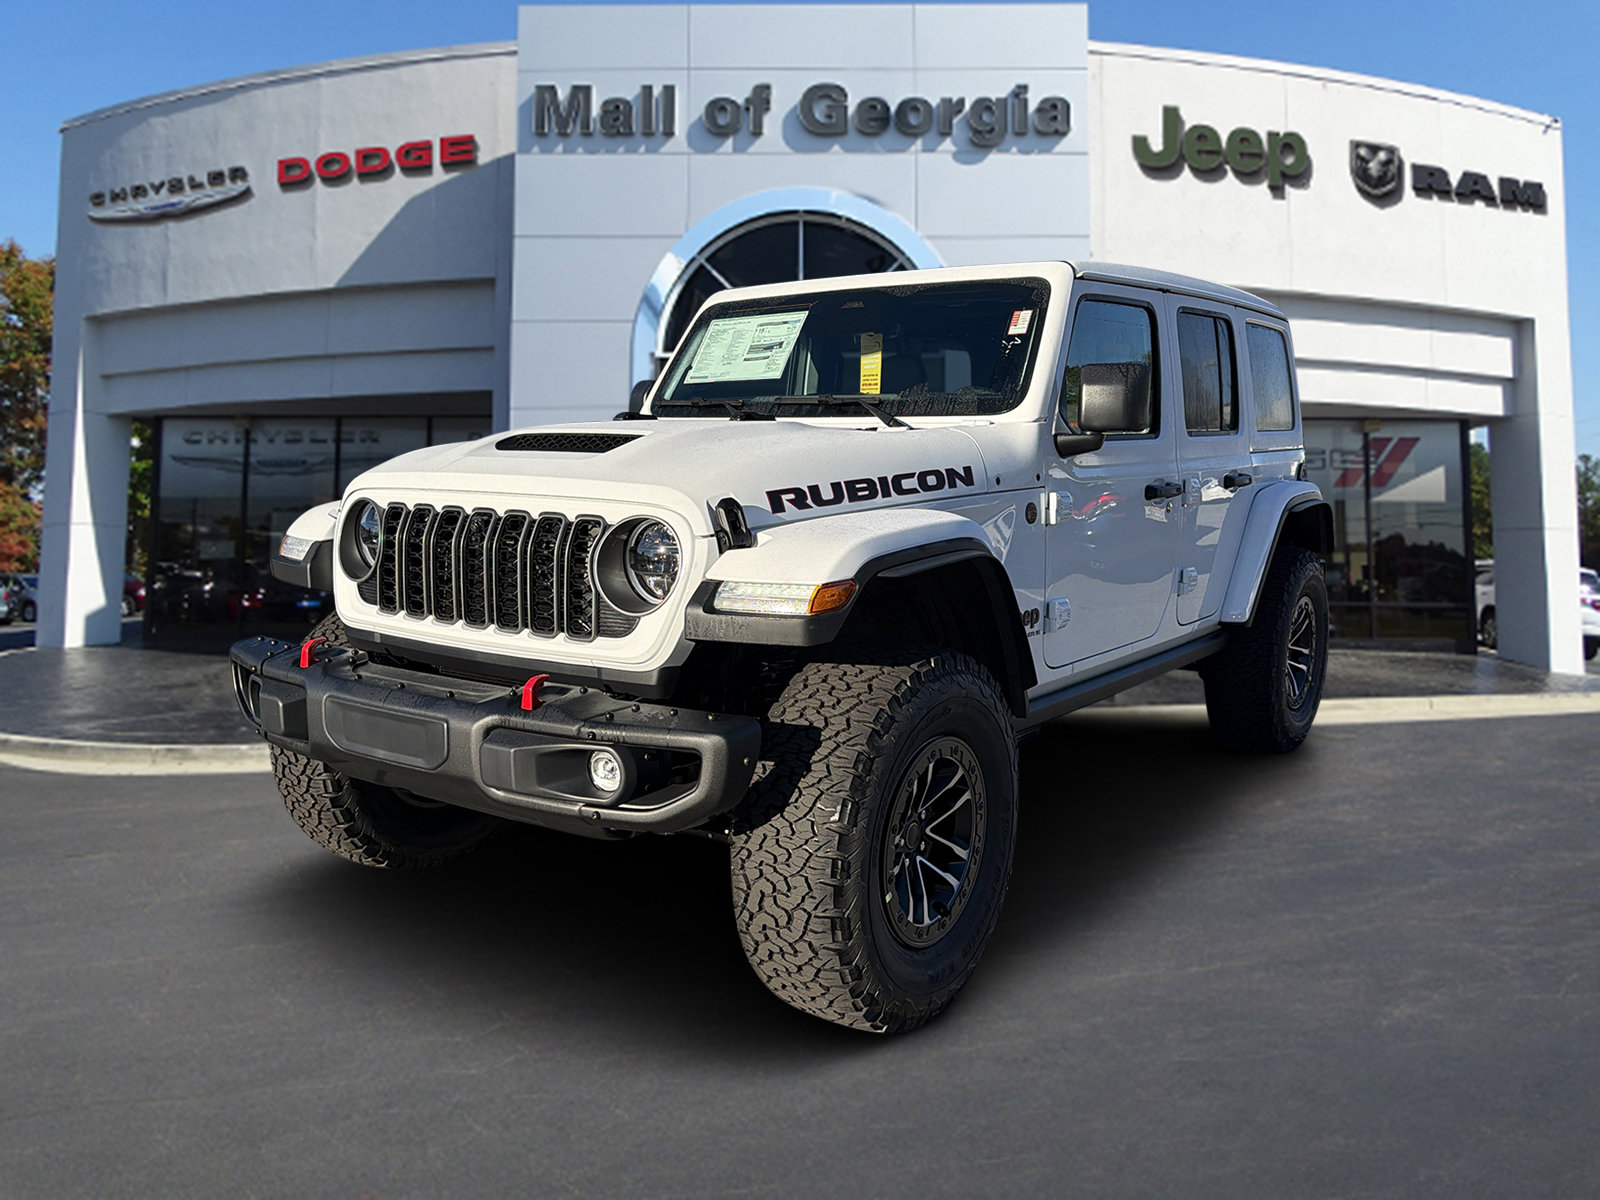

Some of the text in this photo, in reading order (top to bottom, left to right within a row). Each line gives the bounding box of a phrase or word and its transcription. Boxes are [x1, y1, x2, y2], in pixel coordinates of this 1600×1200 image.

[533, 82, 1071, 148] Mall of Georgia
[277, 134, 475, 185] DODGE
[1131, 105, 1308, 188] Jeep
[89, 165, 248, 207] CHRYSLER
[1410, 163, 1545, 211] RAM
[765, 465, 975, 514] RUBICON
[1021, 608, 1040, 629] ep
